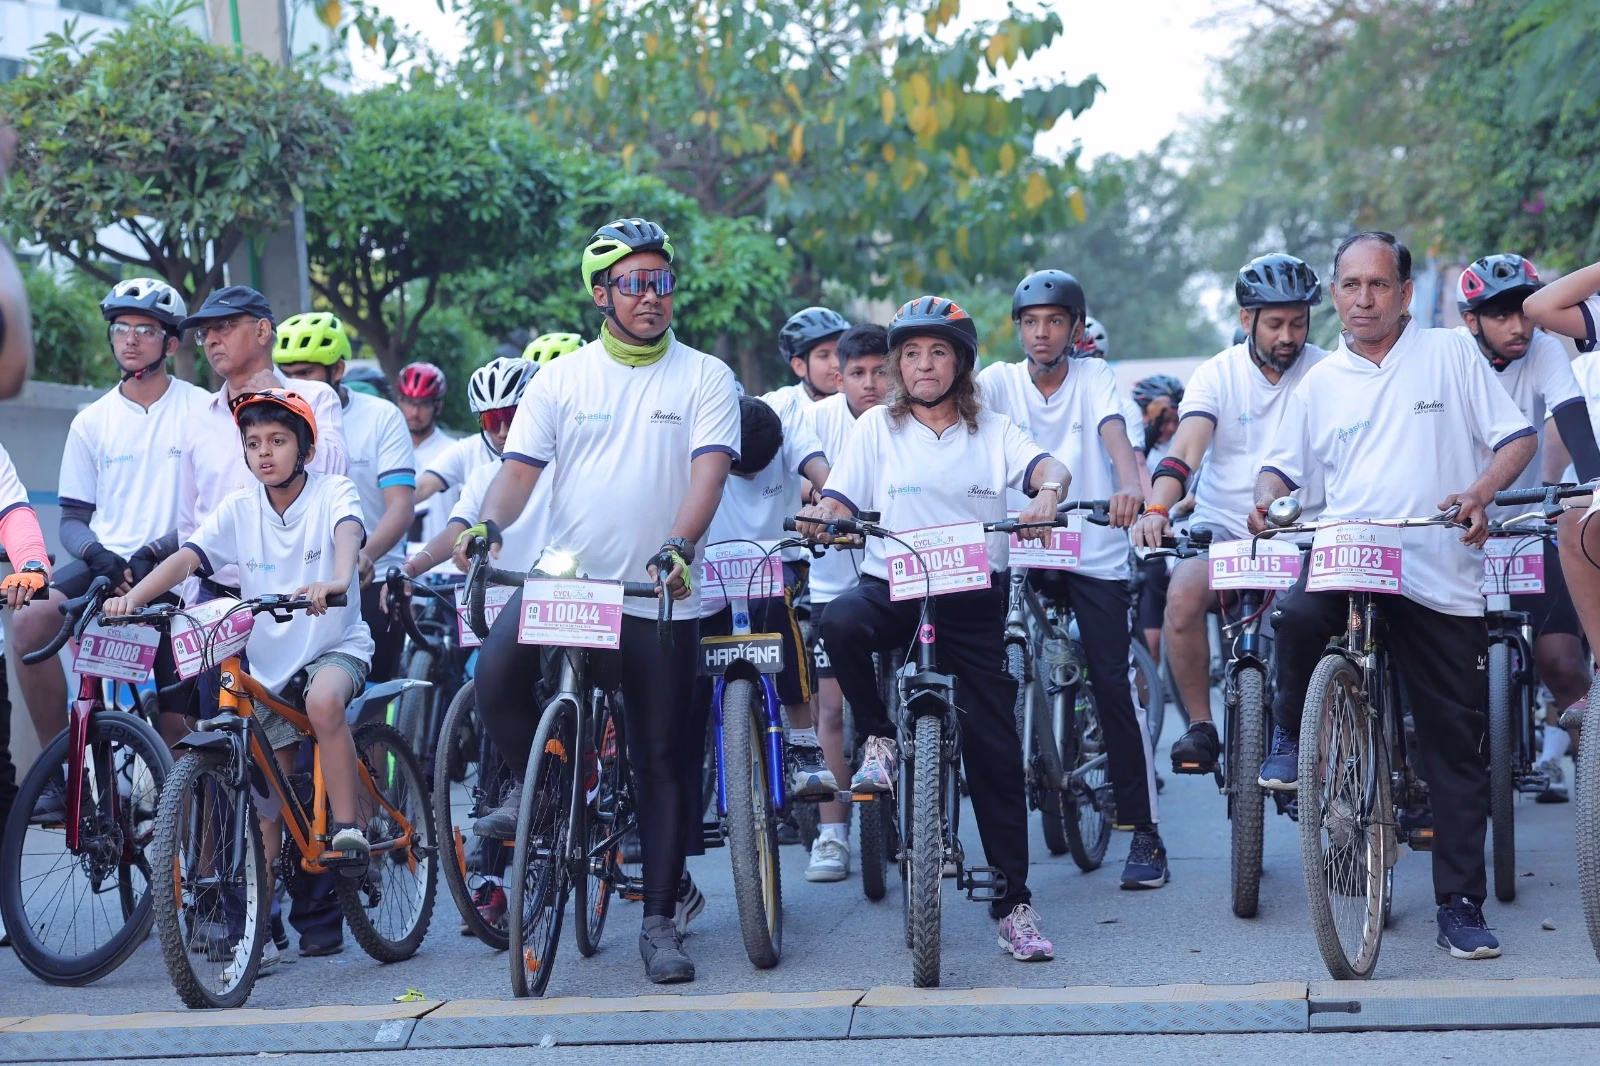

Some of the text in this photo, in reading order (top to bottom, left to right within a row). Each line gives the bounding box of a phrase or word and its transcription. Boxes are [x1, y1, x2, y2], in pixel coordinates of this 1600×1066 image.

[587, 412, 612, 420] asian
[967, 484, 997, 496] Radico
[910, 548, 965, 574] 10049
[1231, 556, 1280, 572] 10015
[1316, 554, 1324, 562] 10
[1330, 546, 1382, 568] 10023
[711, 559, 762, 580] 10005
[894, 561, 903, 570] 10
[528, 606, 538, 614] 10
[546, 602, 600, 624] 10044
[84, 640, 92, 648] 10
[98, 639, 141, 662] 10008
[176, 640, 182, 650] 10
[706, 642, 780, 667] HARYANA
